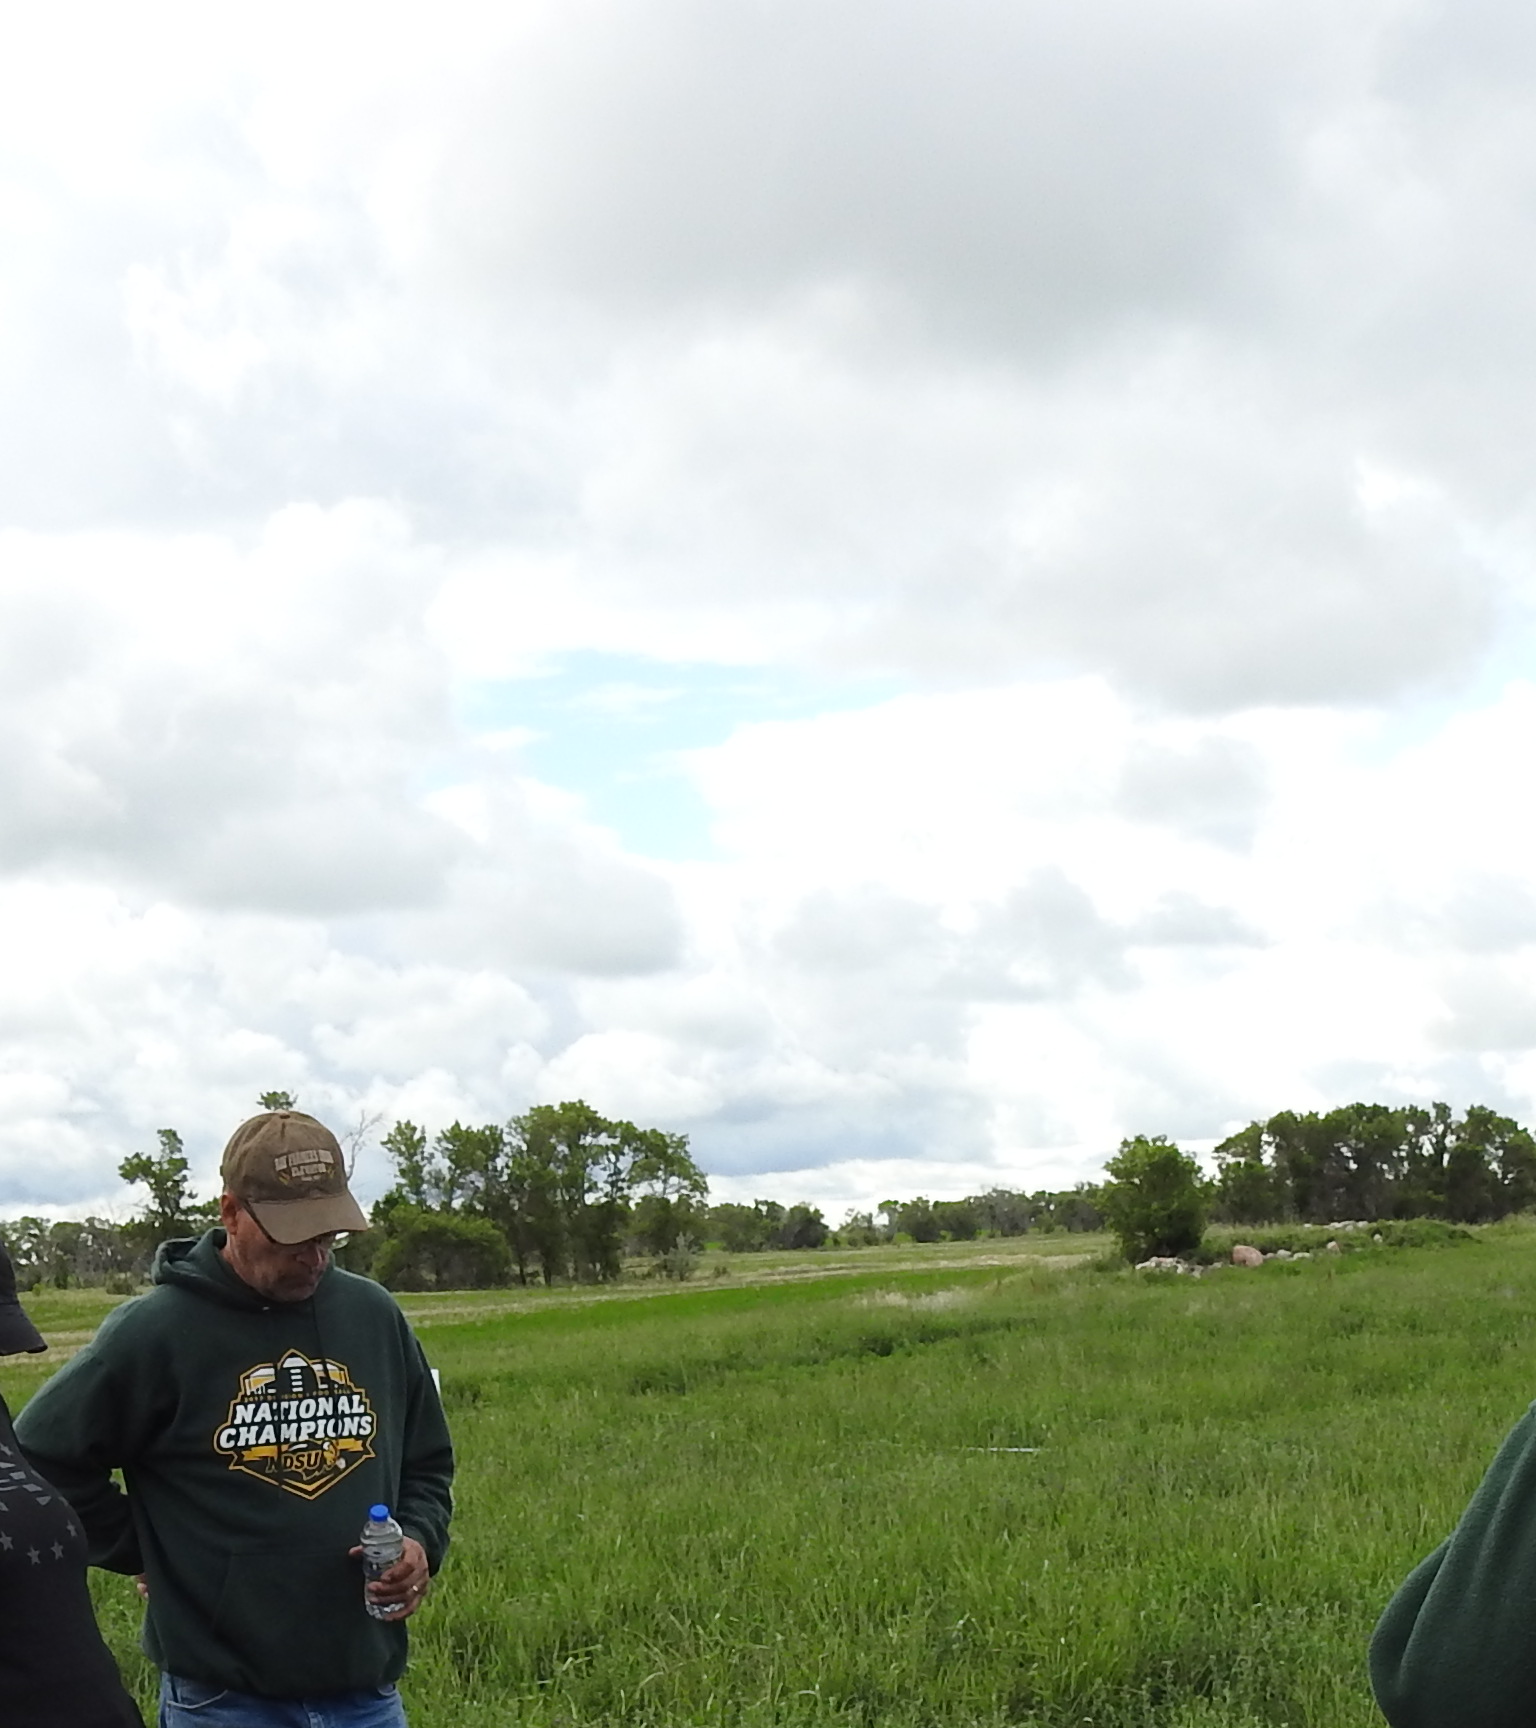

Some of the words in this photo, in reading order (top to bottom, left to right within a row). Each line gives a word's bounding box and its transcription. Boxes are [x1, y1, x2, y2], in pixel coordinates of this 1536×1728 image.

[233, 1395, 365, 1425] NATIONAL
[219, 1416, 372, 1449] CHAMPIONS
[265, 1450, 322, 1474] NDSU
